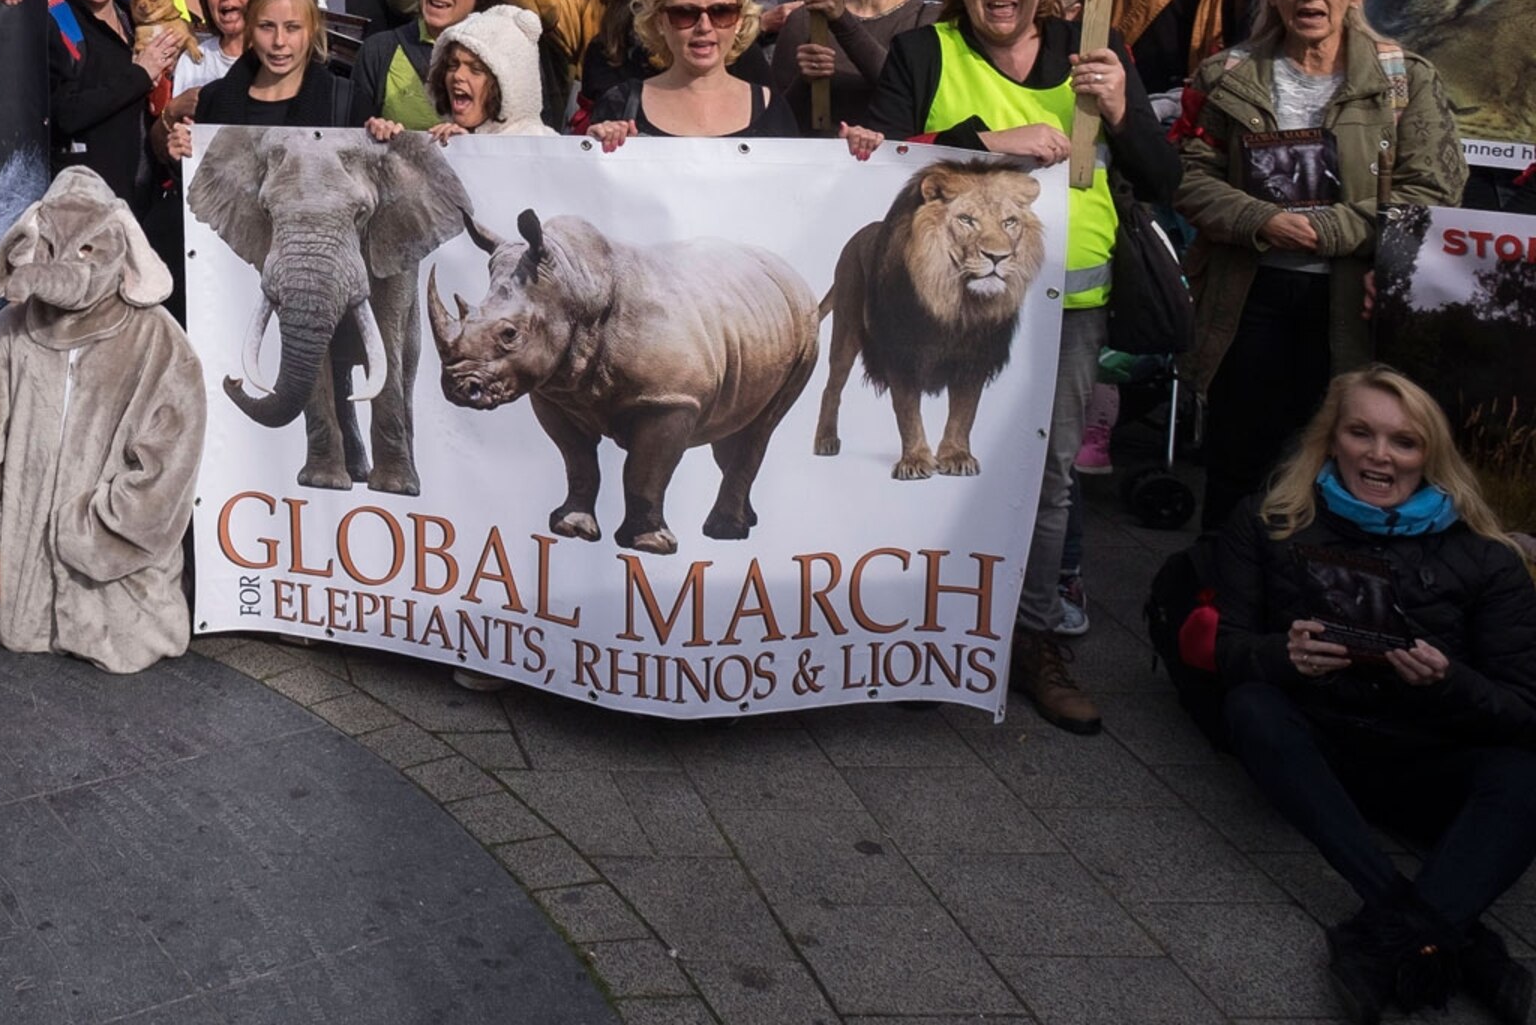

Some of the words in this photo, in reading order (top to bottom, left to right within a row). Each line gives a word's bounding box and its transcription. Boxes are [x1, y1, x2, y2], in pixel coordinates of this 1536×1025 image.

[217, 491, 581, 628] GLOBAL
[616, 546, 1005, 648] MARCH
[240, 575, 261, 616] FOR
[272, 578, 556, 685] ELEPHANTS,
[572, 638, 777, 704] RHINOS
[792, 648, 825, 696] &
[841, 641, 997, 694] LIONS
